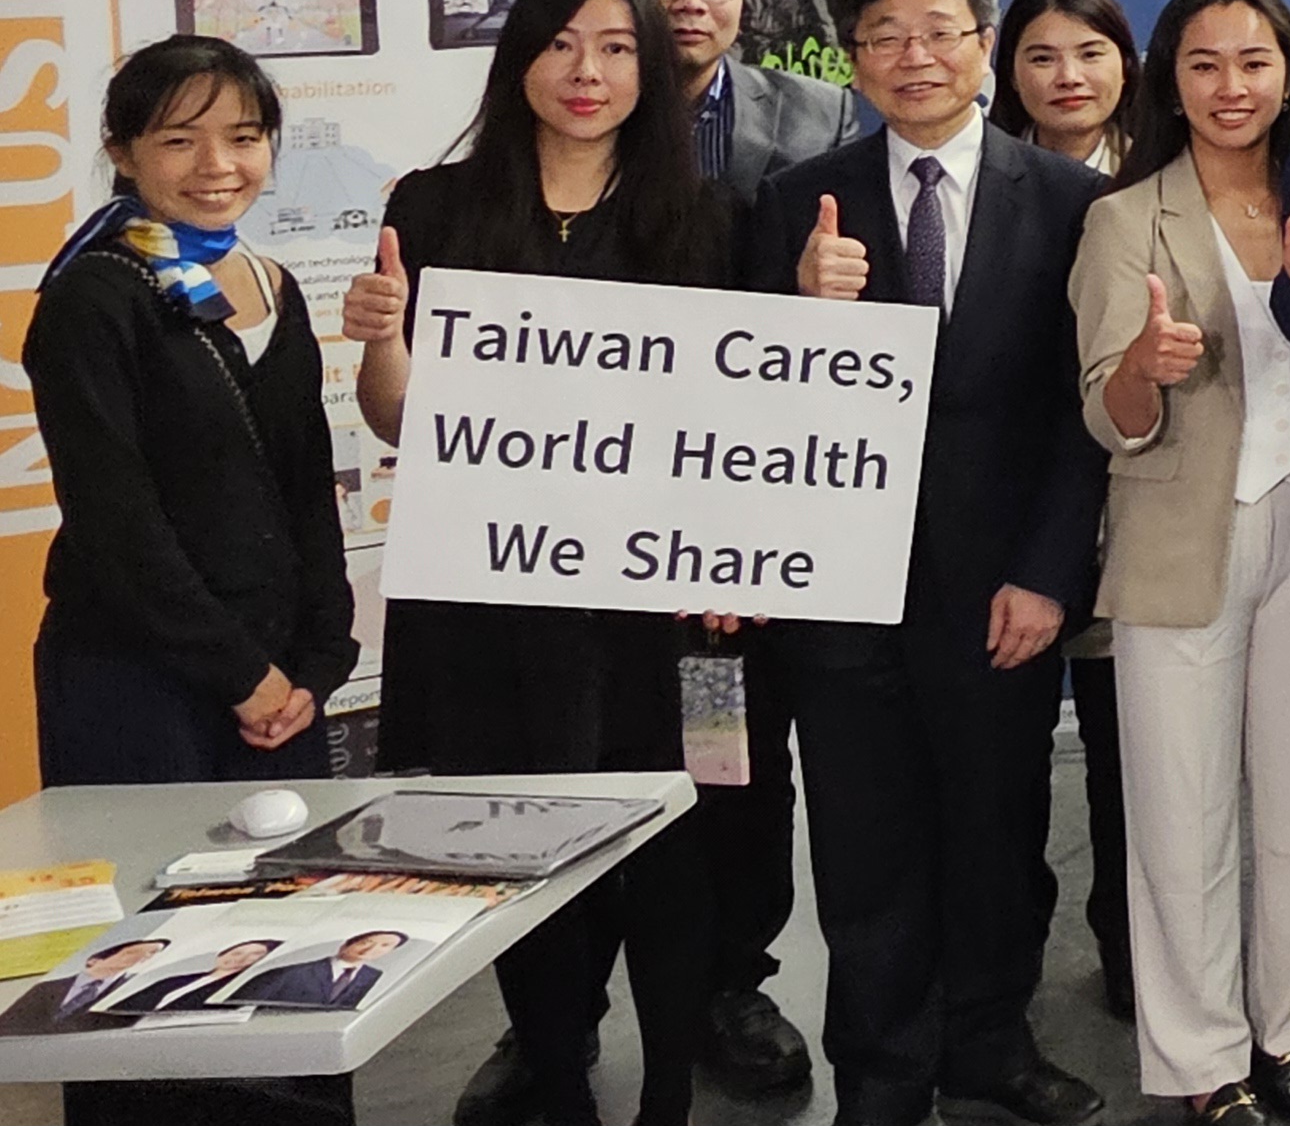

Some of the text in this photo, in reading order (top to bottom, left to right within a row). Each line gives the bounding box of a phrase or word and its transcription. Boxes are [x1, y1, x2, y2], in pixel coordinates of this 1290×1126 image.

[430, 307, 915, 403] Taiwan Cares,
[433, 413, 888, 490] World Health
[487, 521, 815, 589] We Share
